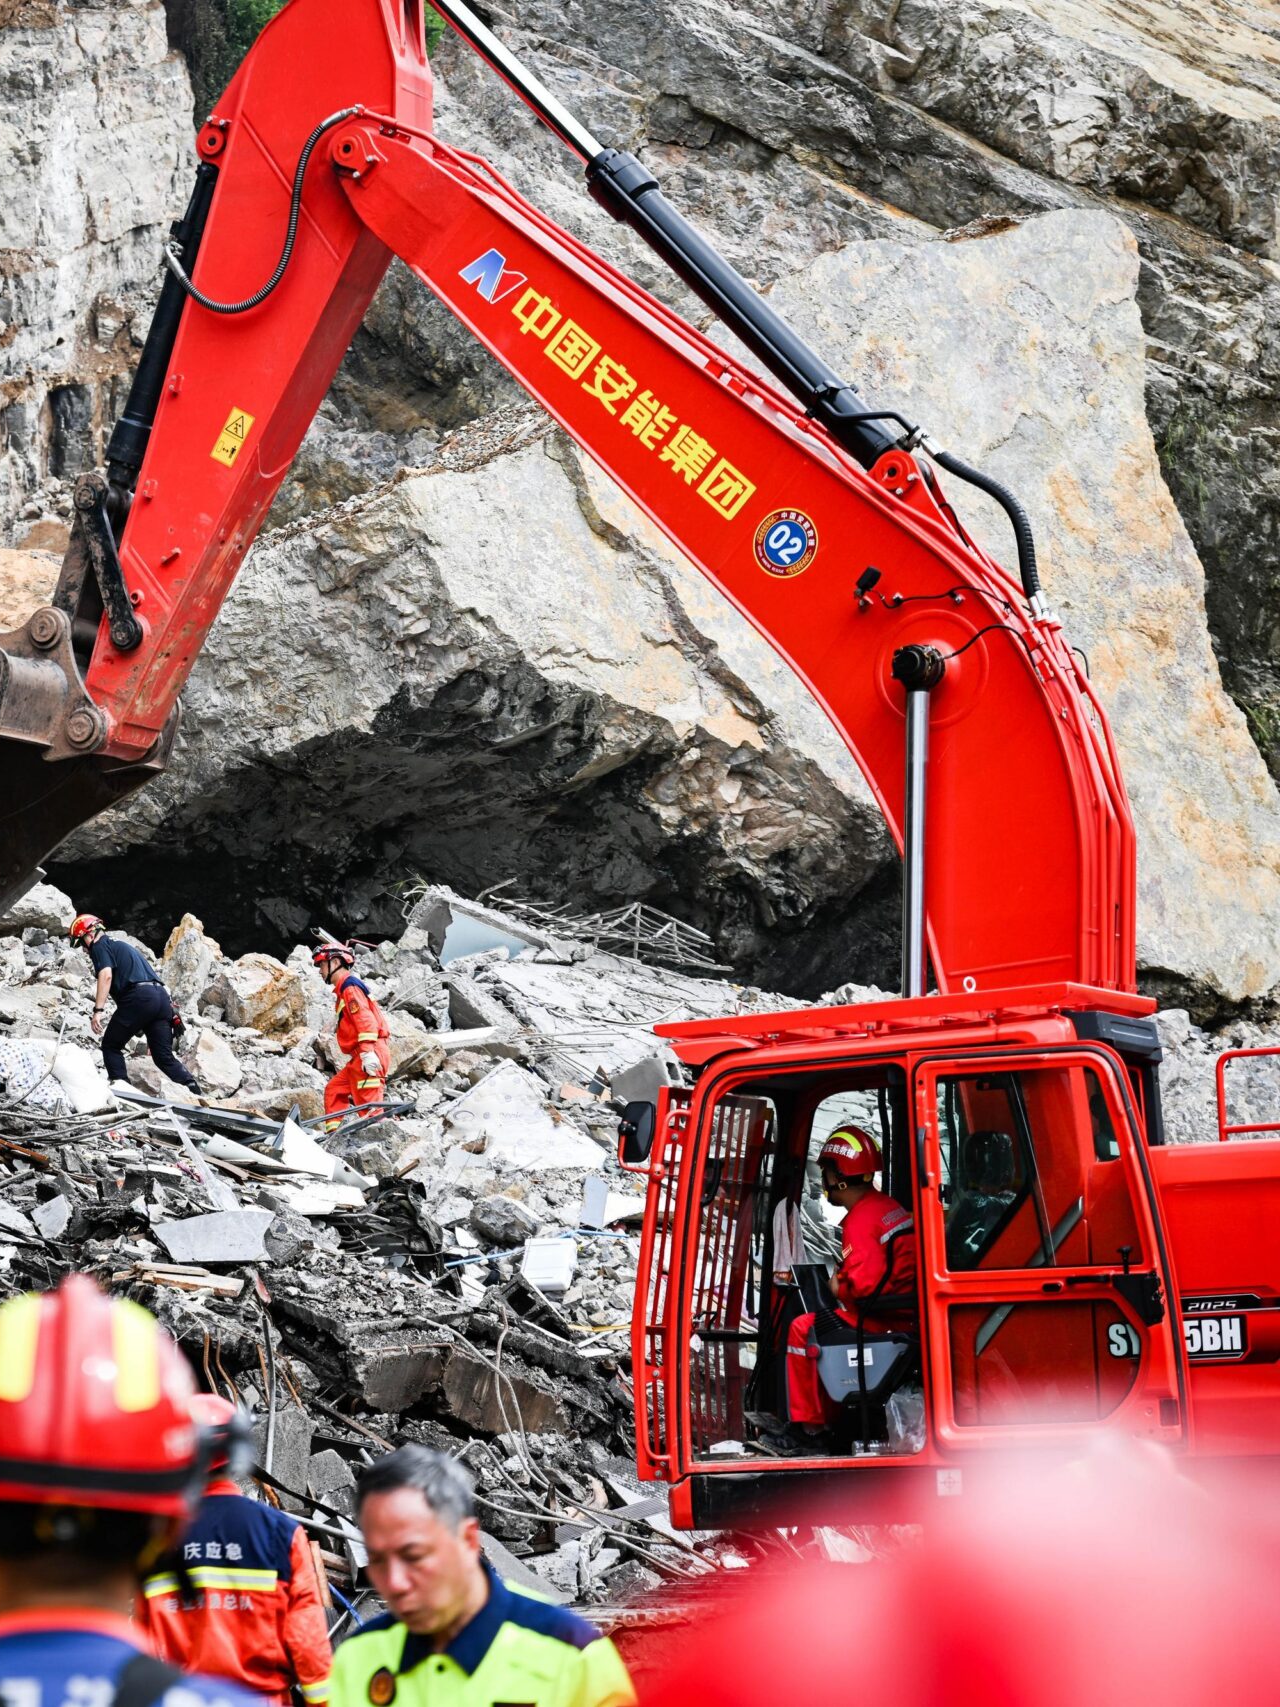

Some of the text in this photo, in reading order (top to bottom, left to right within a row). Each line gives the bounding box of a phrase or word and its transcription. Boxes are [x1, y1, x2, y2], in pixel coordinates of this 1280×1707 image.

[511, 287, 757, 521] 中国安能集团
[768, 524, 803, 565] 02
[1188, 1300, 1238, 1312] 2025
